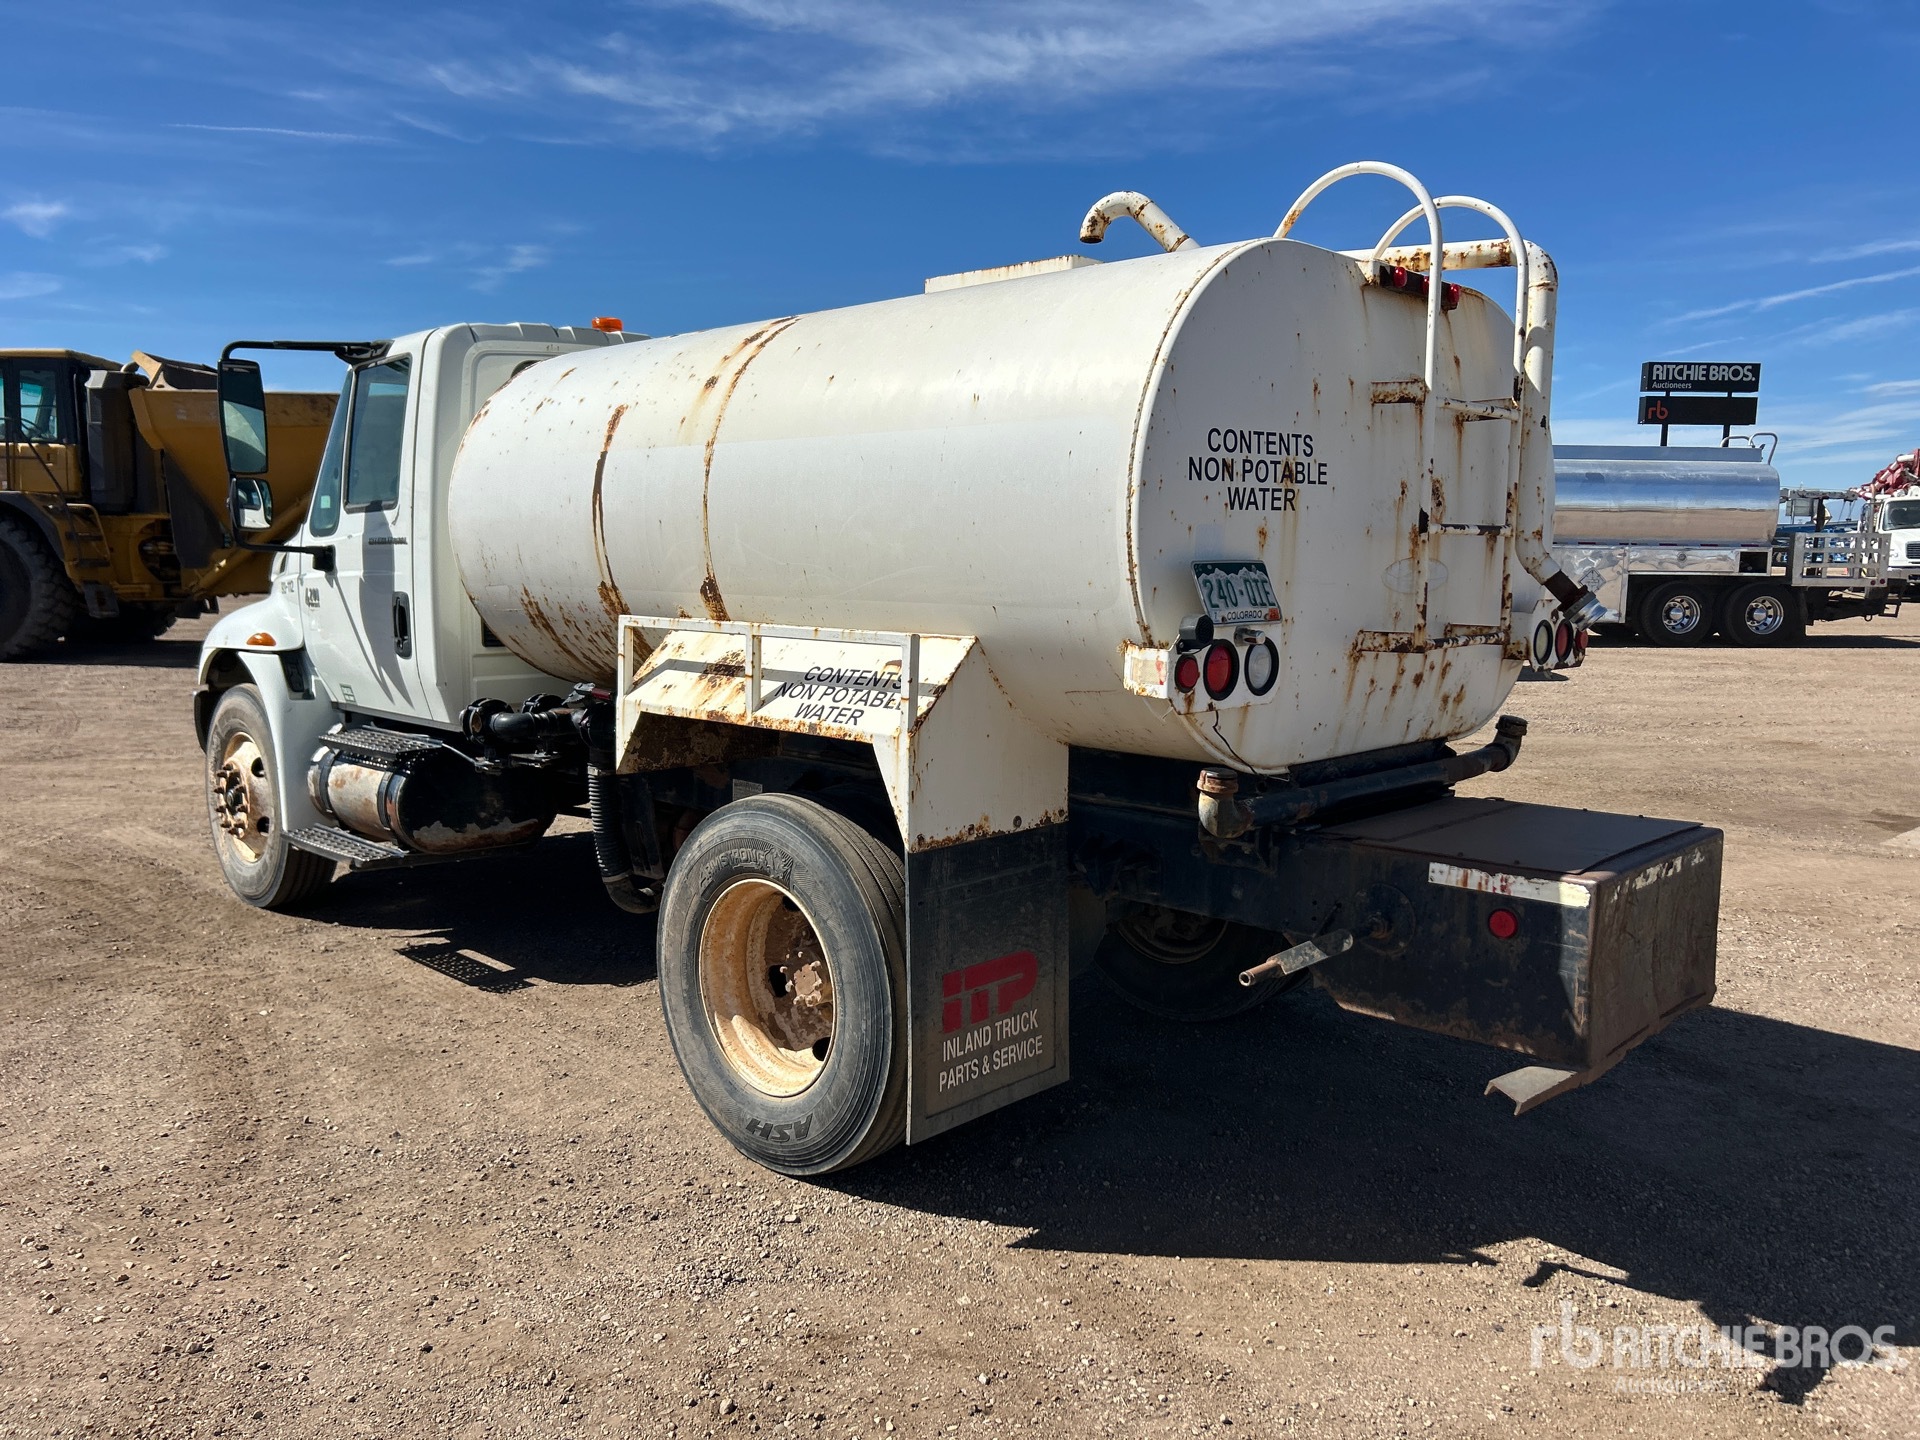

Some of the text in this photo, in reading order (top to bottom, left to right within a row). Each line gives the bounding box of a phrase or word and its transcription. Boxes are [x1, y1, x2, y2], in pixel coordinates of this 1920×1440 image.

[1652, 364, 1756, 382] RITCHIE BROS.
[1651, 381, 1692, 390] Auctioneers
[1647, 400, 1669, 420] rb
[1207, 427, 1314, 458] CONTENTS
[1188, 456, 1328, 485] NON POTABLE
[1227, 486, 1296, 512] WATER
[1226, 610, 1263, 621] COLORADO
[804, 666, 901, 690] CONTENTS
[774, 682, 819, 699] NON
[794, 702, 865, 726] WATER
[943, 1008, 1038, 1062] INLAND TRUCK
[939, 1035, 1043, 1092] PARTS & SERVICE
